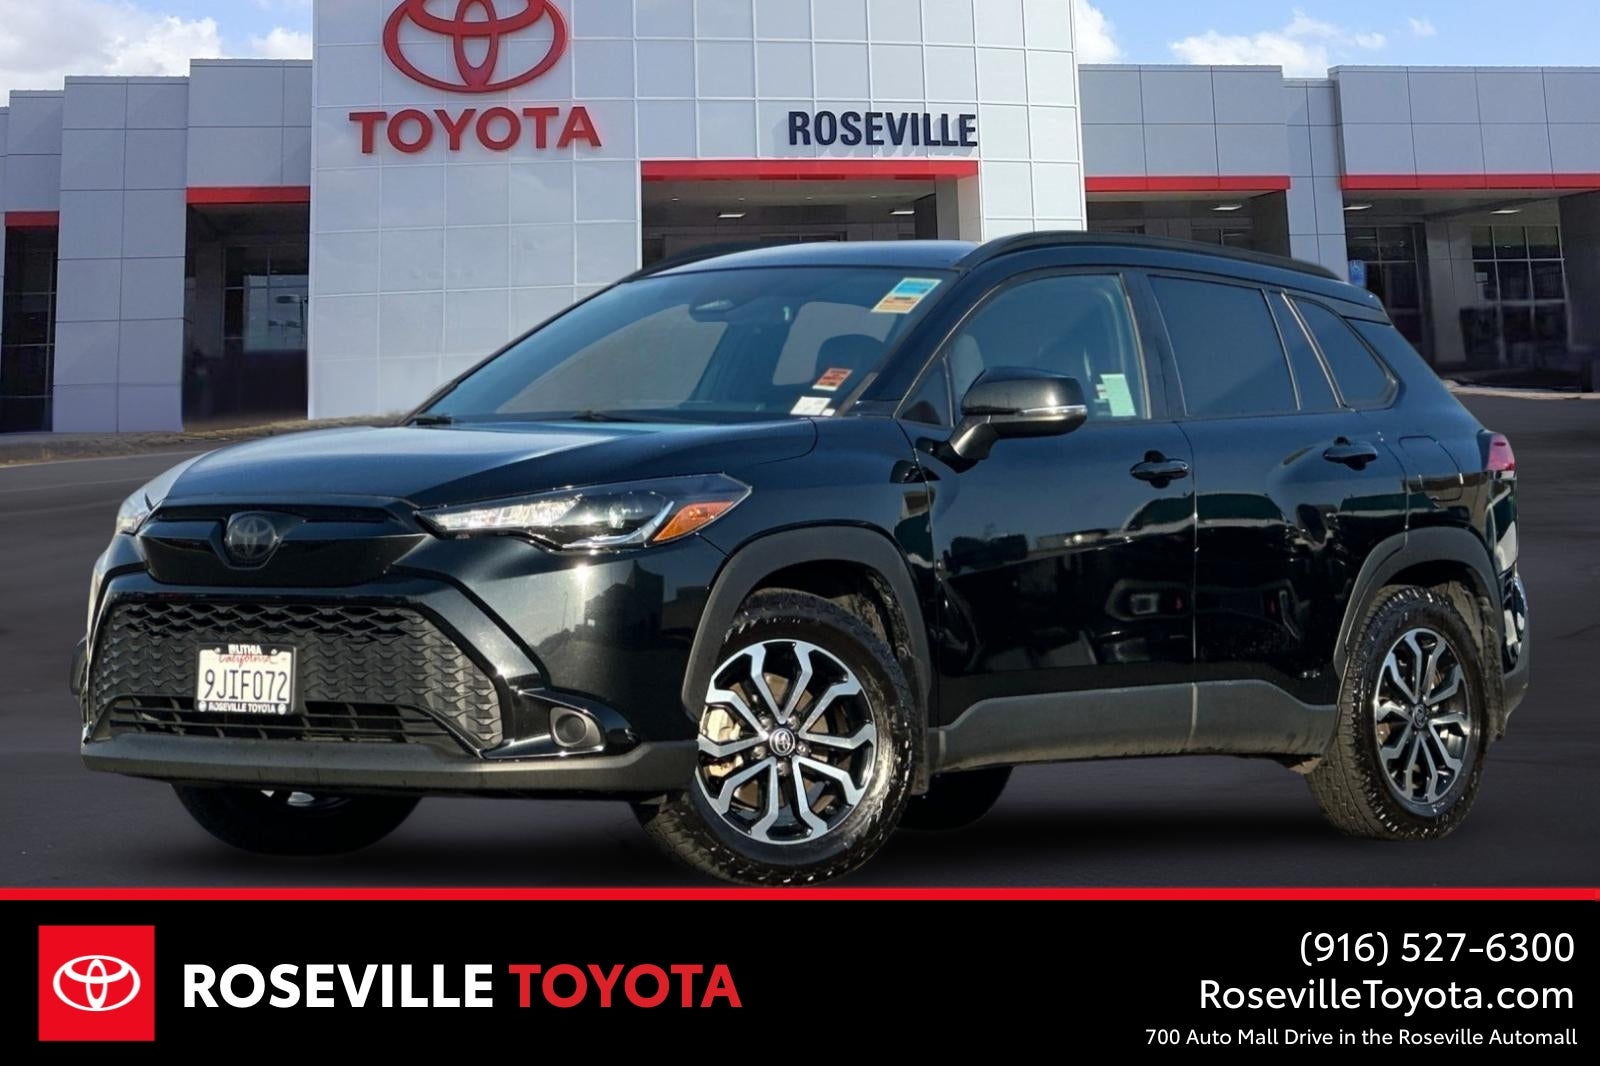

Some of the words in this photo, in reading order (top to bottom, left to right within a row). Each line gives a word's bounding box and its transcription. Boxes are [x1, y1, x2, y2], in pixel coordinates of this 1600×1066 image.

[349, 106, 602, 154] TOYOTA
[788, 111, 978, 147] ROSEVILLE
[204, 668, 288, 701] 9JIF072
[208, 702, 247, 713] ROSEVILLE
[248, 703, 276, 713] TOYOTA
